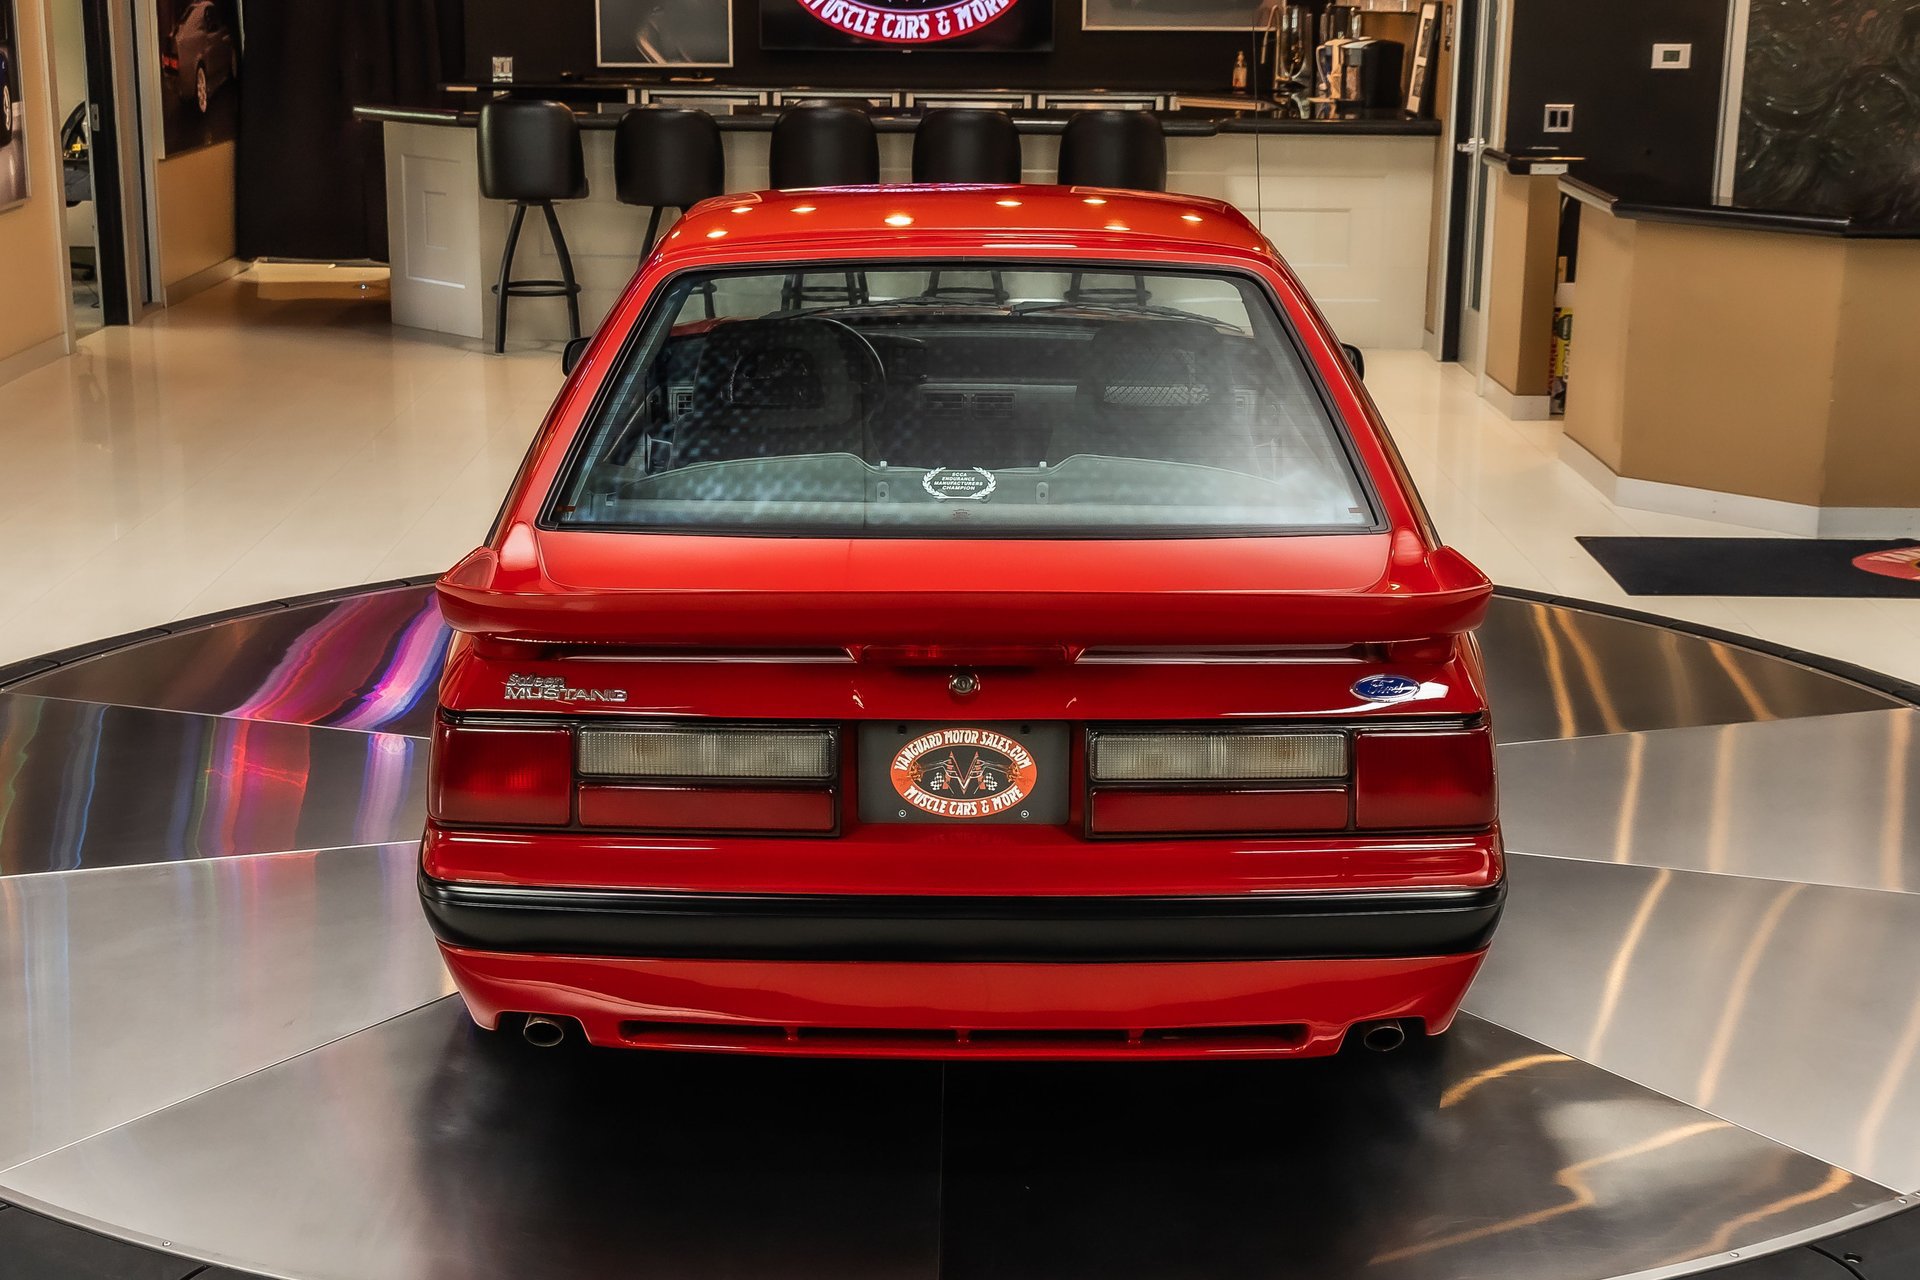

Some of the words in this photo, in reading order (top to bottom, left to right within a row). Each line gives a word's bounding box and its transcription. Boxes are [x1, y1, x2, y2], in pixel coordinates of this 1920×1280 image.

[881, 13, 930, 39] CARS
[935, 10, 951, 36] &
[503, 686, 628, 702] MUSTANG
[1367, 679, 1404, 695] Ford
[894, 732, 942, 771] VANGUARD
[943, 729, 979, 745] MOTOR
[980, 731, 1032, 769] SALES.COM
[903, 785, 948, 814] MUSCLE
[949, 800, 978, 816] CARS
[980, 799, 990, 814] &
[990, 785, 1024, 811] MORE
